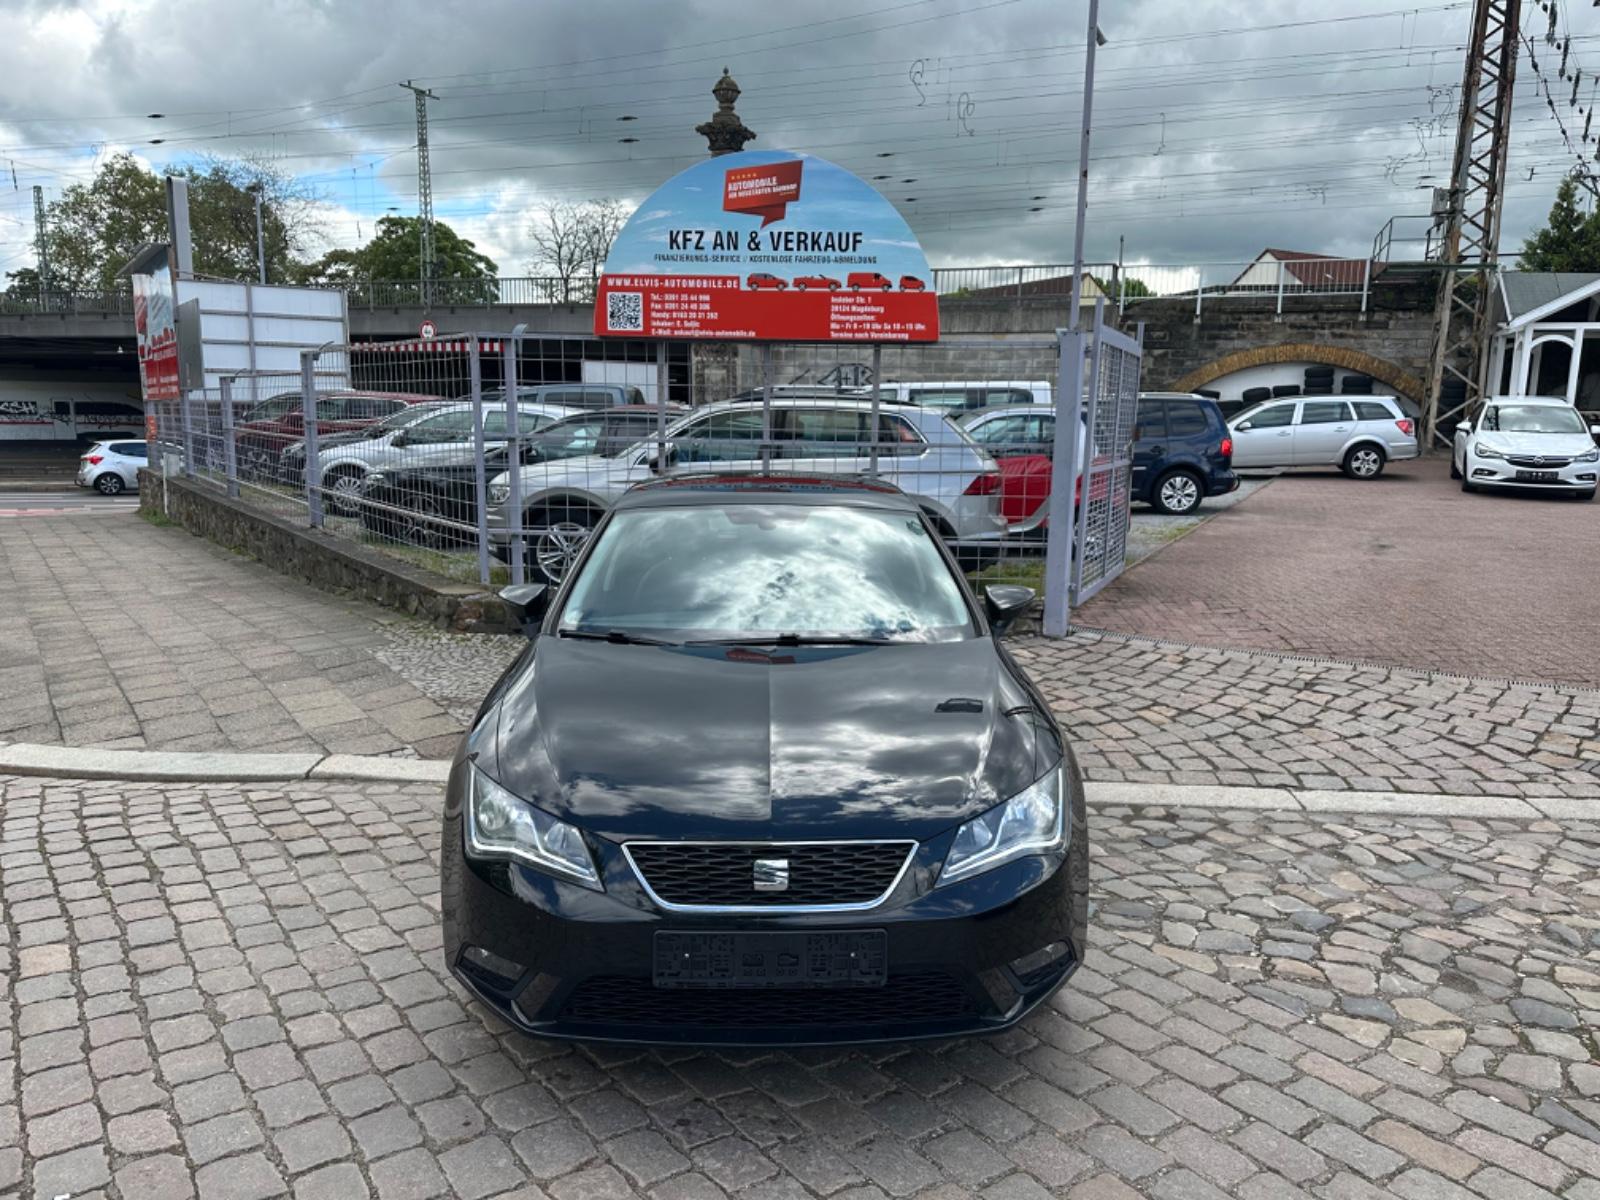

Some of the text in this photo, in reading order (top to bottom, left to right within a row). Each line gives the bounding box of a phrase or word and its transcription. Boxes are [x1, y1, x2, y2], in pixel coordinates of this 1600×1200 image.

[728, 176, 777, 191] AUTOMOBILE
[669, 230, 863, 252] KFZ AN & VERKAUF
[654, 253, 740, 263] FINANZIERUNGS-SERVICE
[750, 255, 793, 263] KOSTENLOSE
[794, 255, 877, 264] FAHRZEUG-ABMELDUNG
[606, 278, 738, 289] WWW.ELVIS-AUTOMOBILE.DE
[851, 305, 885, 314] Magdeburg
[830, 331, 854, 339] Termine
[869, 332, 909, 340] Vereinbarung
